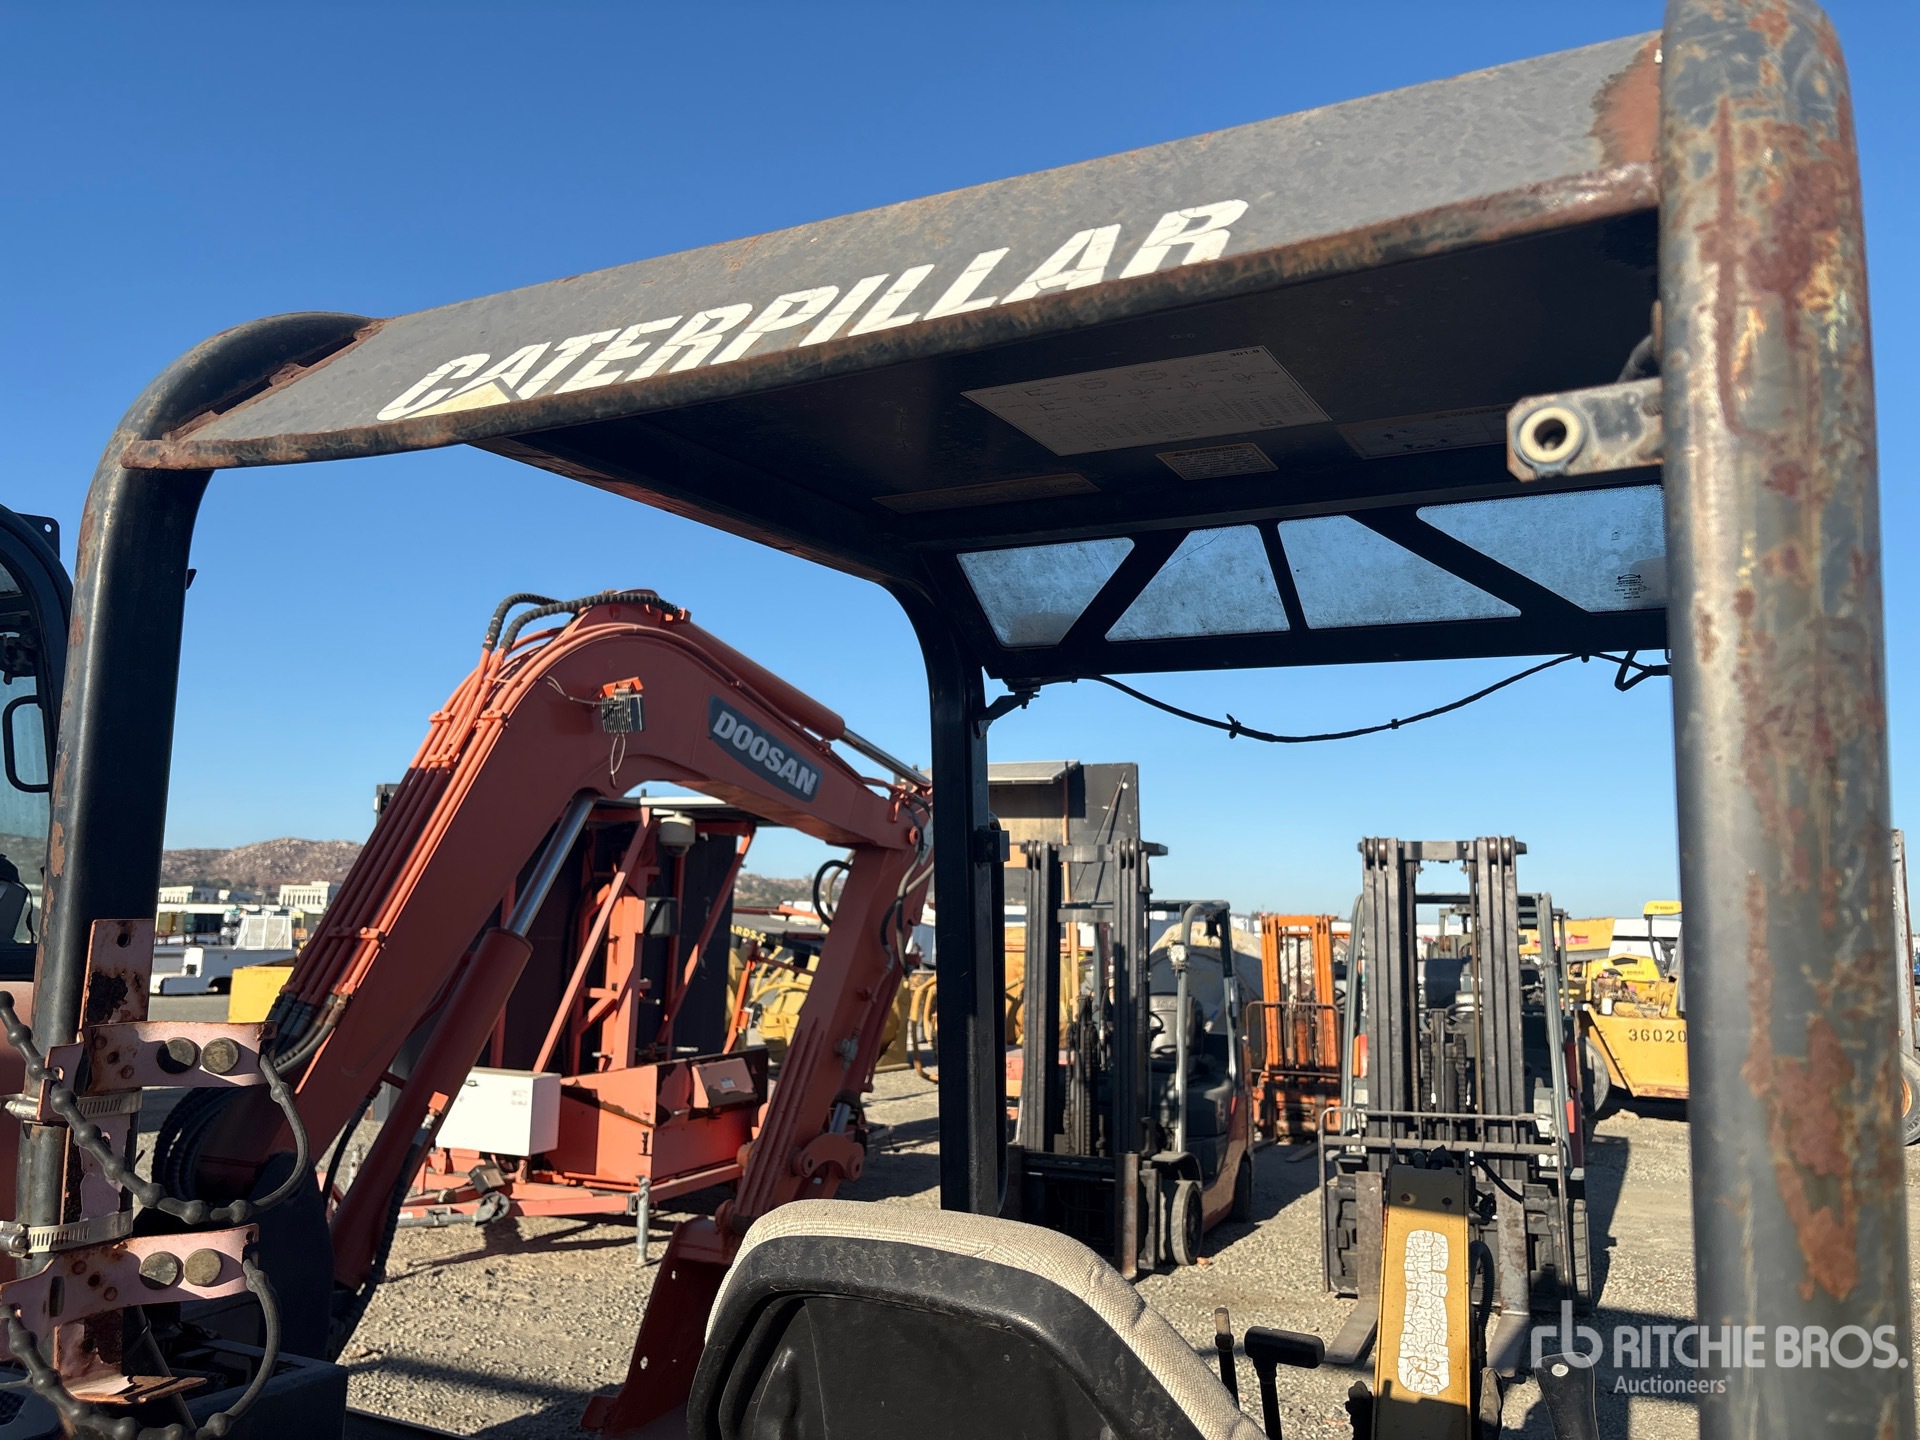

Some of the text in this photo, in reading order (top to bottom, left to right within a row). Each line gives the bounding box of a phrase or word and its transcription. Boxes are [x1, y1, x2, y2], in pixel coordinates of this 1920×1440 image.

[376, 199, 1249, 421] CATERPILLAR
[713, 710, 817, 796] DOOSAN
[1628, 1028, 1687, 1043] 36020
